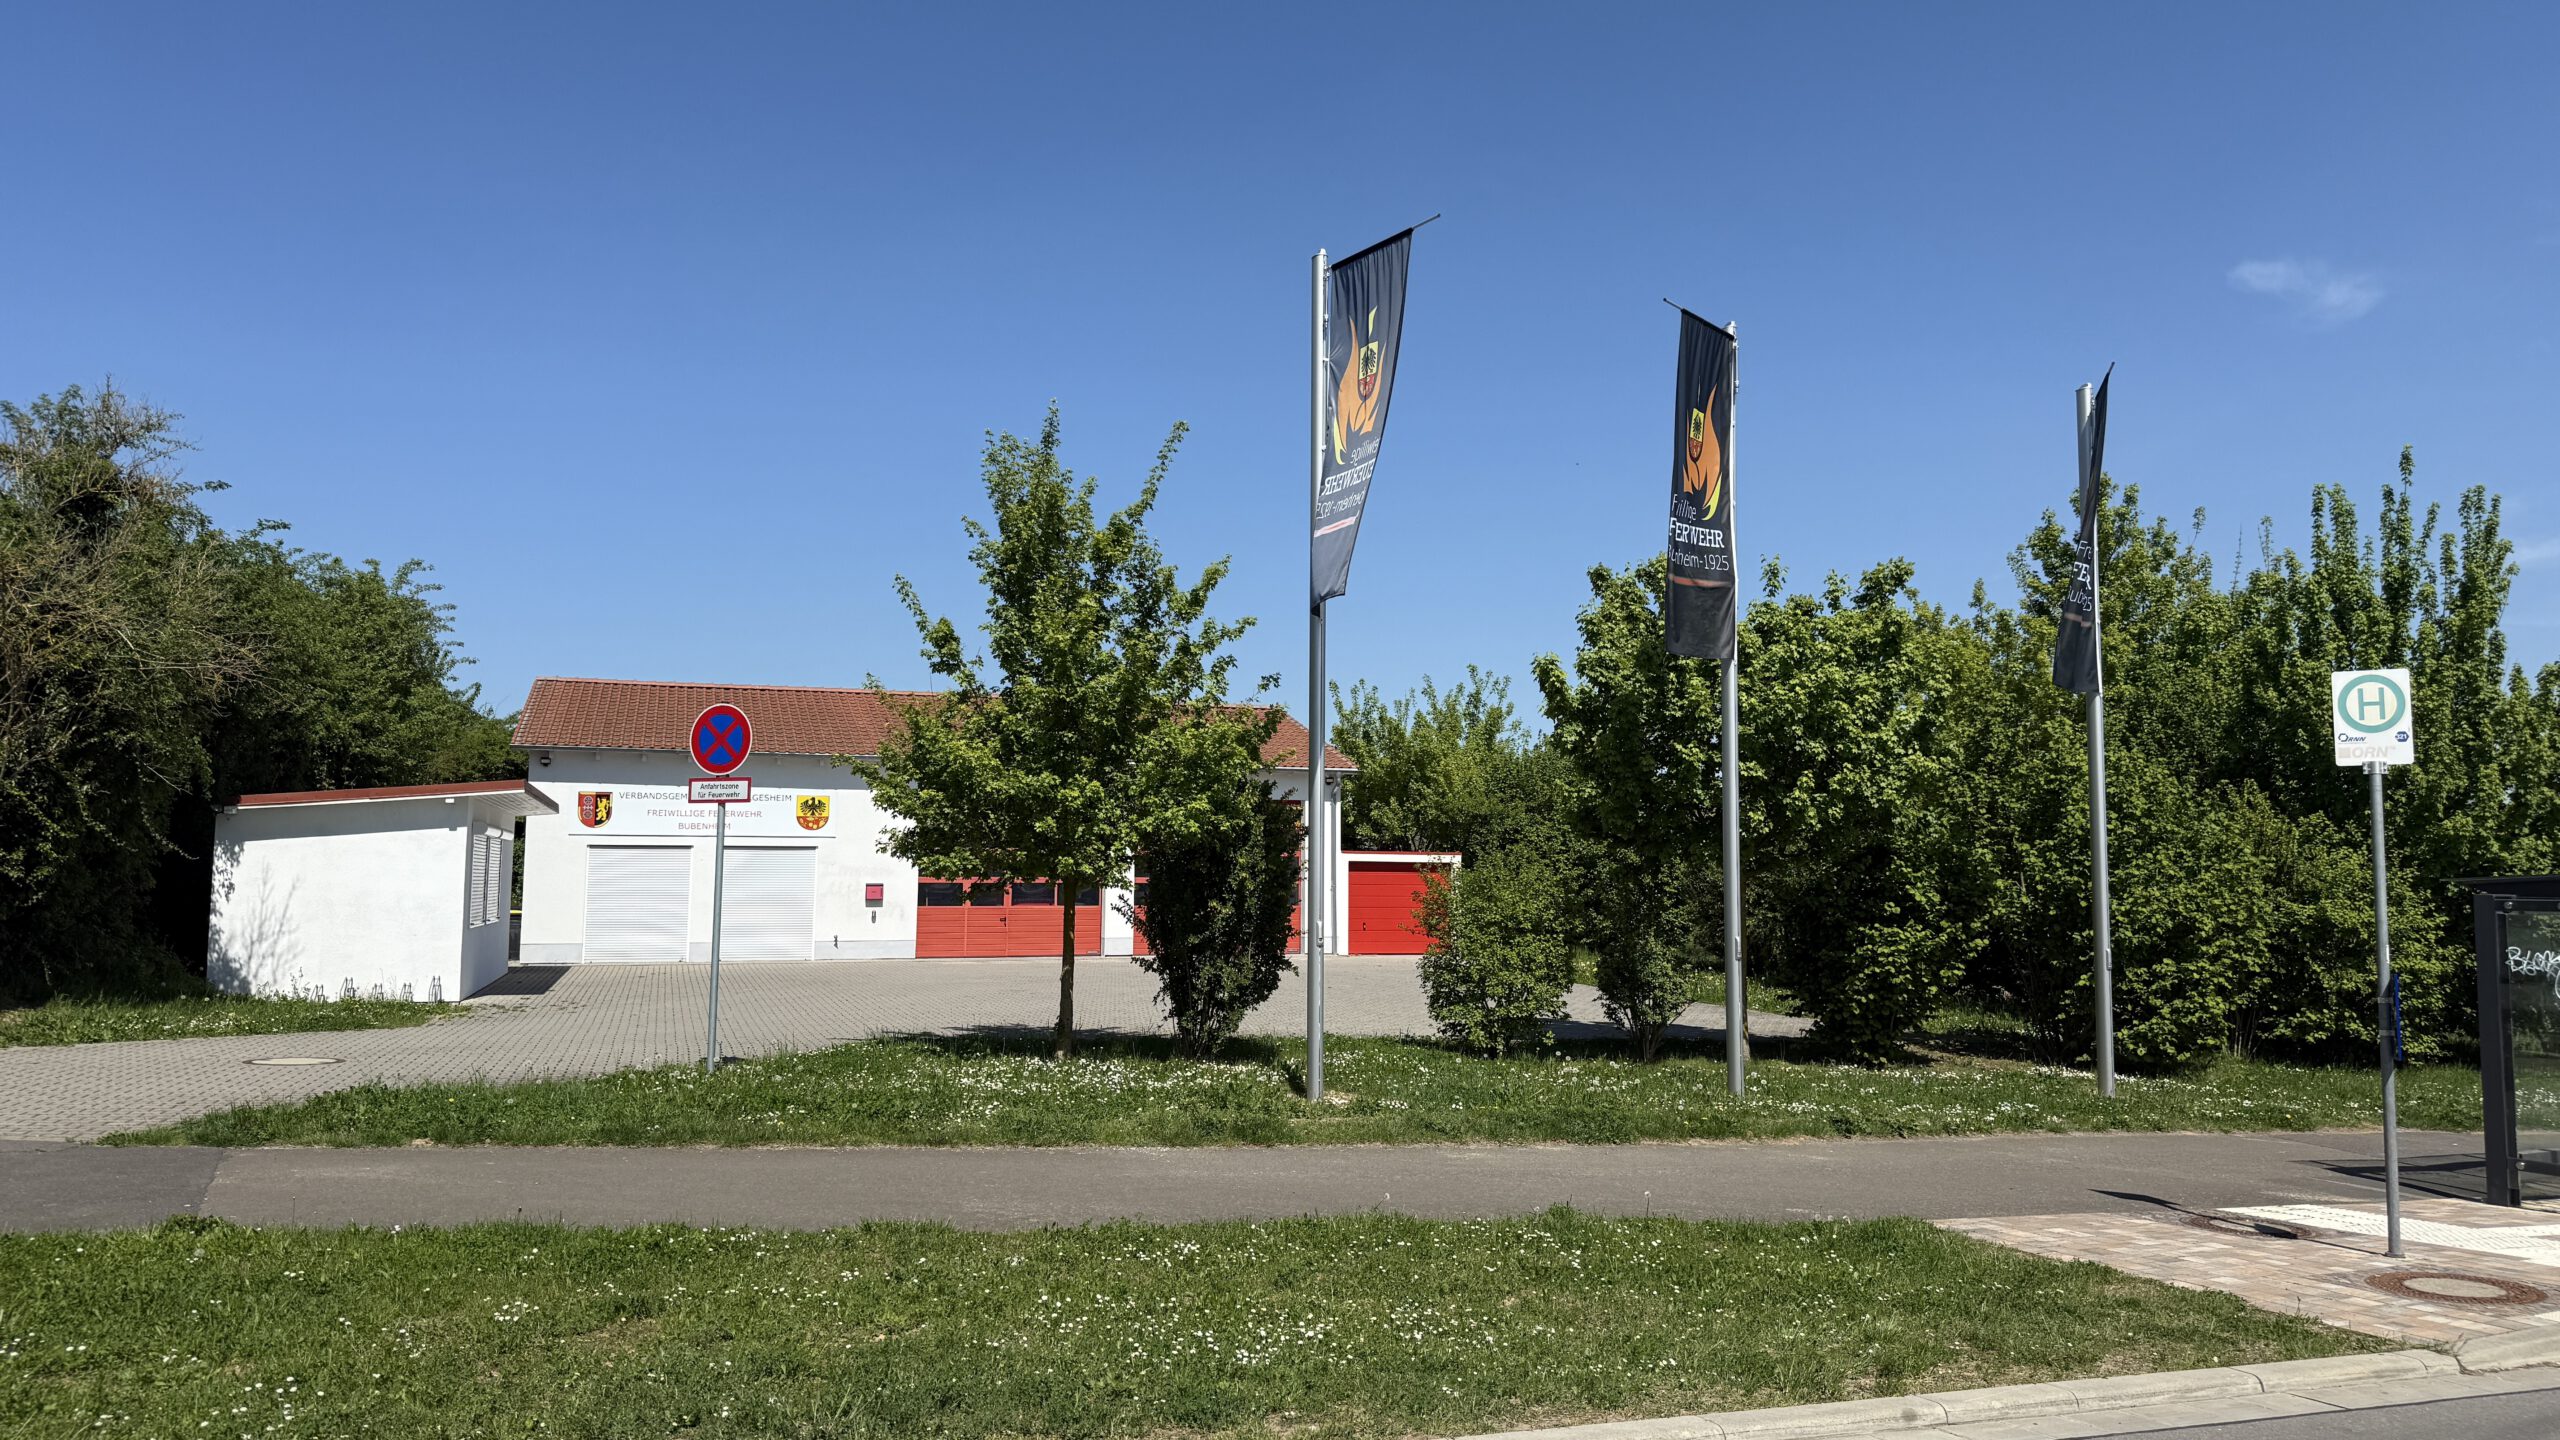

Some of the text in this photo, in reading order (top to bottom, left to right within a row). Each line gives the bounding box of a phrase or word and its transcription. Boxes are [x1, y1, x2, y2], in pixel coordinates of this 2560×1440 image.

[2357, 687, 2386, 720] H
[619, 791, 688, 800] VERBANDSGEM
[647, 809, 763, 818] FREIWILLIGE FEERWEHR
